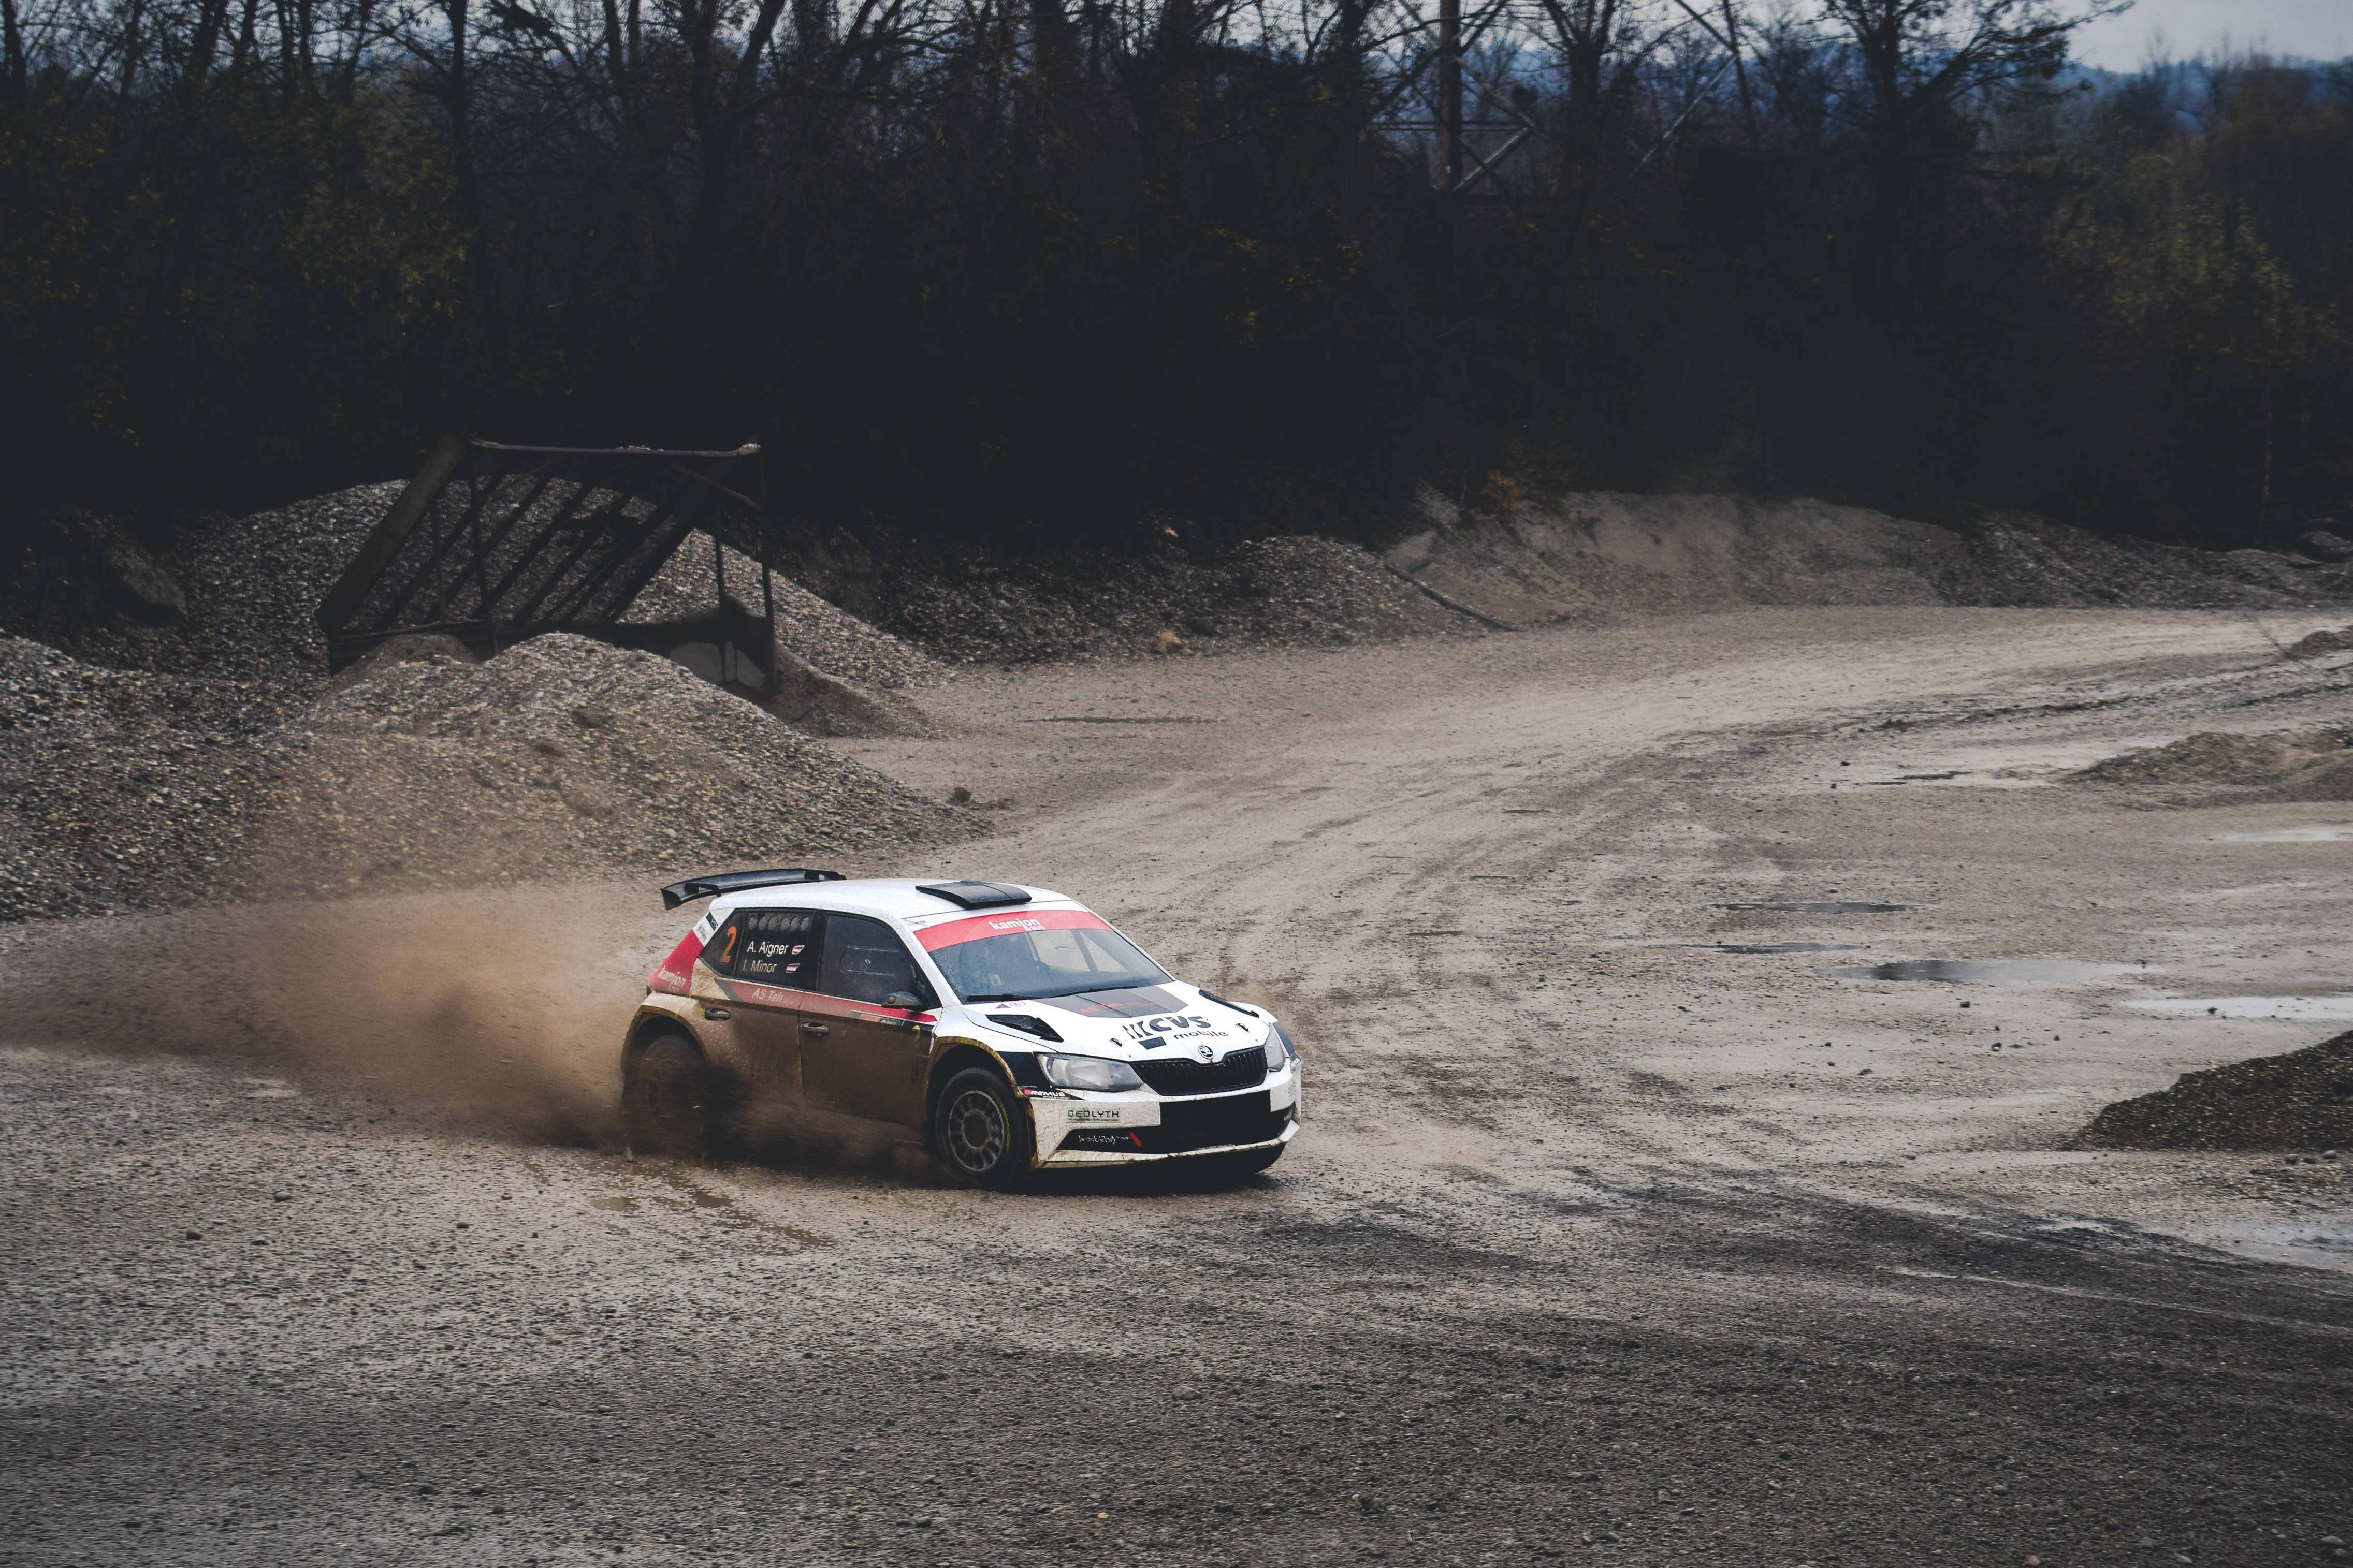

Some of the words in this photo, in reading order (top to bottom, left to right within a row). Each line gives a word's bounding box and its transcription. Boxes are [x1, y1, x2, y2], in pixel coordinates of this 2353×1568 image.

[719, 926, 737, 963] 2
[747, 940, 756, 954] A.
[758, 941, 789, 957] Aigner
[751, 959, 777, 973] Minor
[752, 988, 766, 1000] AS
[1173, 1030, 1229, 1039] mobile
[1067, 1109, 1120, 1118] GEOLYTH
